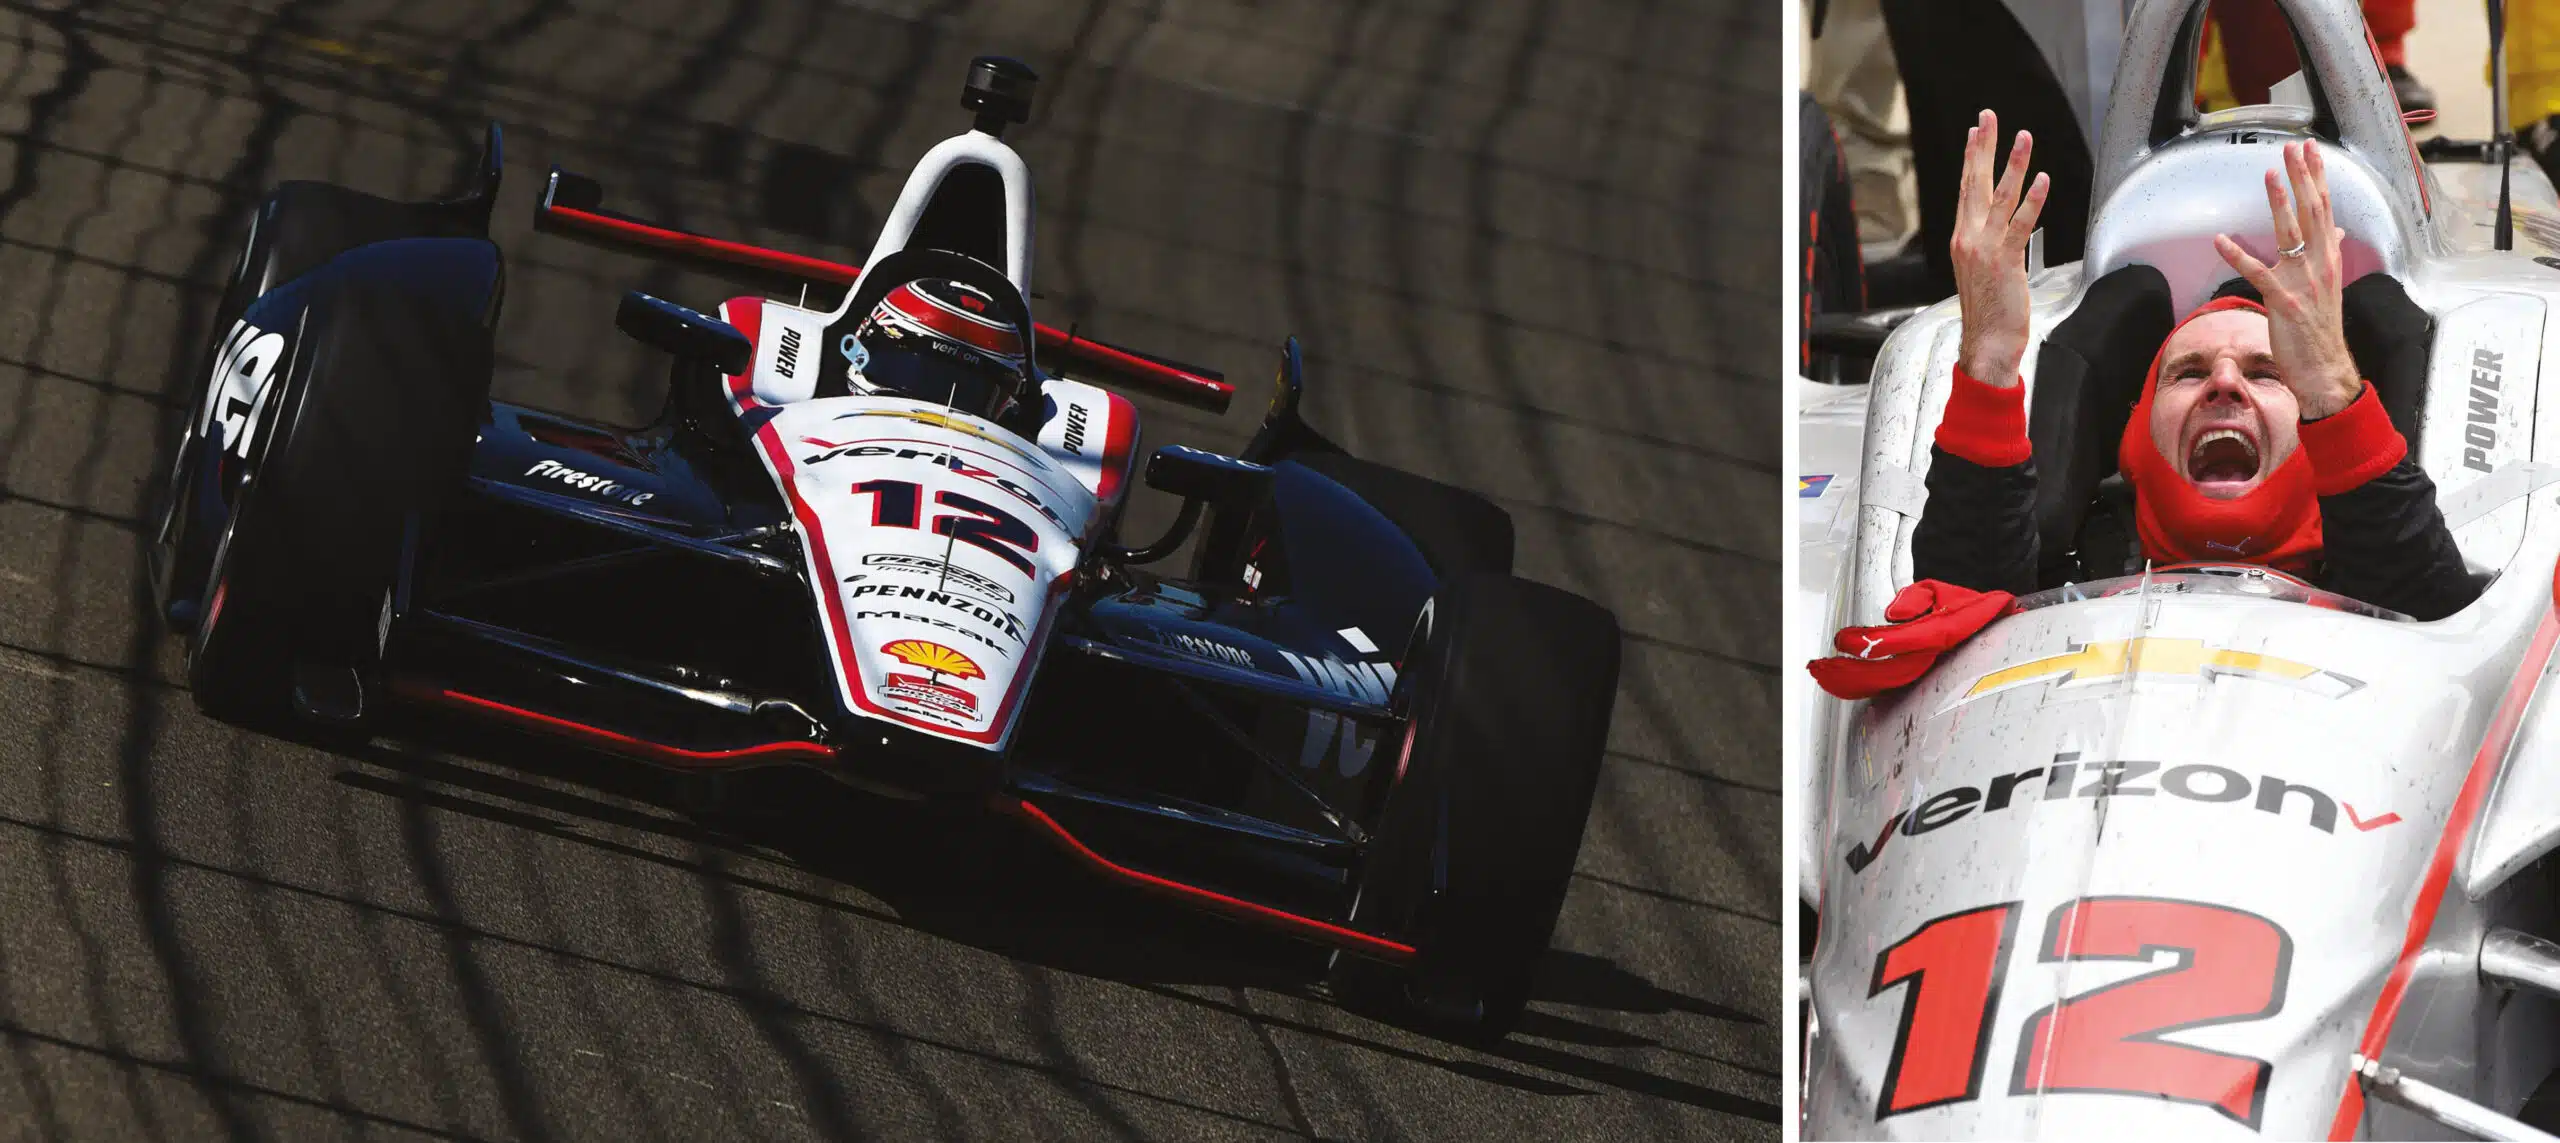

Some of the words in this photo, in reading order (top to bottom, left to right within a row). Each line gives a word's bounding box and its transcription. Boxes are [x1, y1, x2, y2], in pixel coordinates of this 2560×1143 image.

[775, 326, 801, 379] POWER
[1063, 402, 1088, 456] POWER
[2463, 348, 2503, 473] POWER
[803, 446, 1076, 538] verizon
[851, 479, 1039, 582] 12
[852, 584, 1021, 643] PENNZOIL
[1845, 751, 2338, 876] verizon
[1866, 896, 2295, 1134] 12
